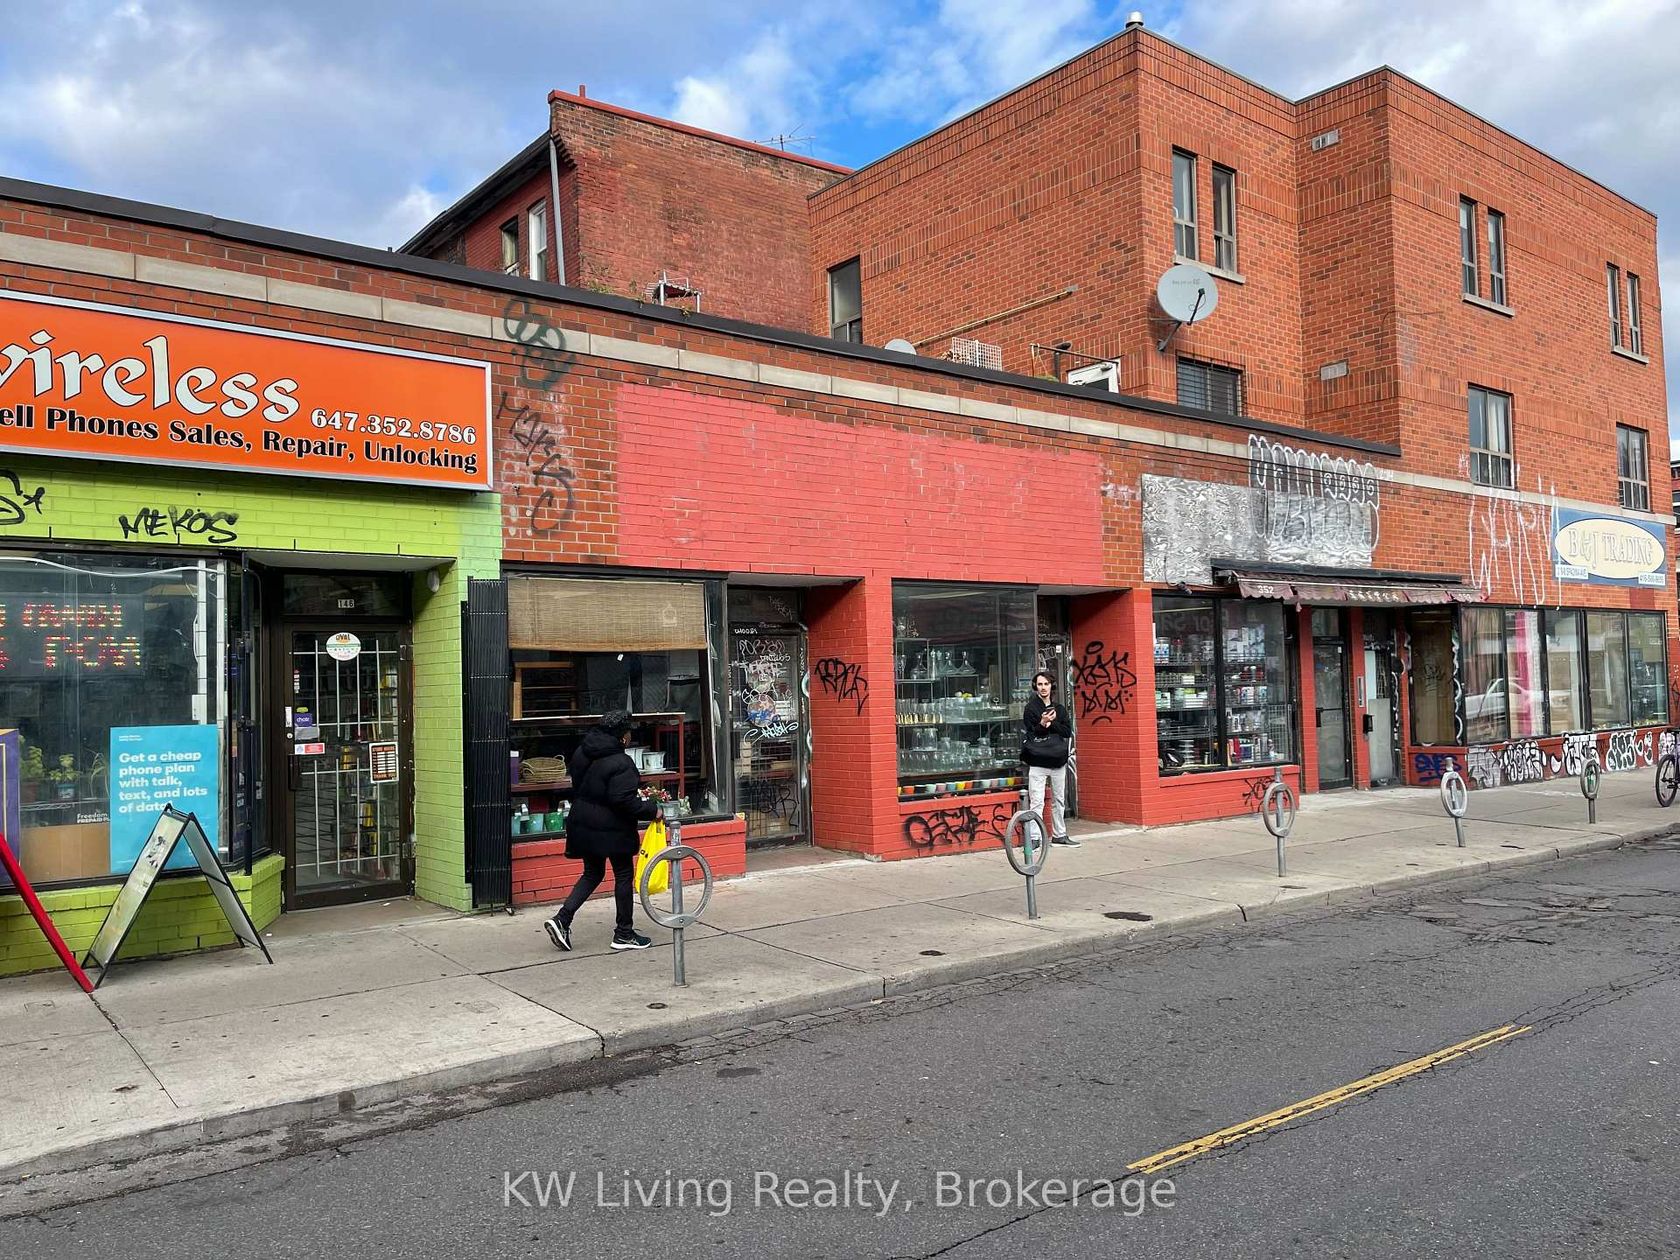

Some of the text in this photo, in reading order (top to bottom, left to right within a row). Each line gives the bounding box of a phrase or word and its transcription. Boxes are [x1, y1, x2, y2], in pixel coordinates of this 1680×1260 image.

[311, 408, 477, 444] 647.352.8786
[46, 407, 159, 440] Phones
[169, 418, 252, 452] Sales,
[262, 430, 355, 462] Repair,
[363, 440, 478, 475] Unlocking
[1602, 532, 1653, 566] TRADING
[1256, 584, 1275, 594] 352
[119, 751, 202, 762] Get a cheap
[119, 763, 195, 778] phone plan
[119, 775, 182, 788] with talk,
[119, 786, 208, 801] text, and lots
[119, 802, 135, 813] of
